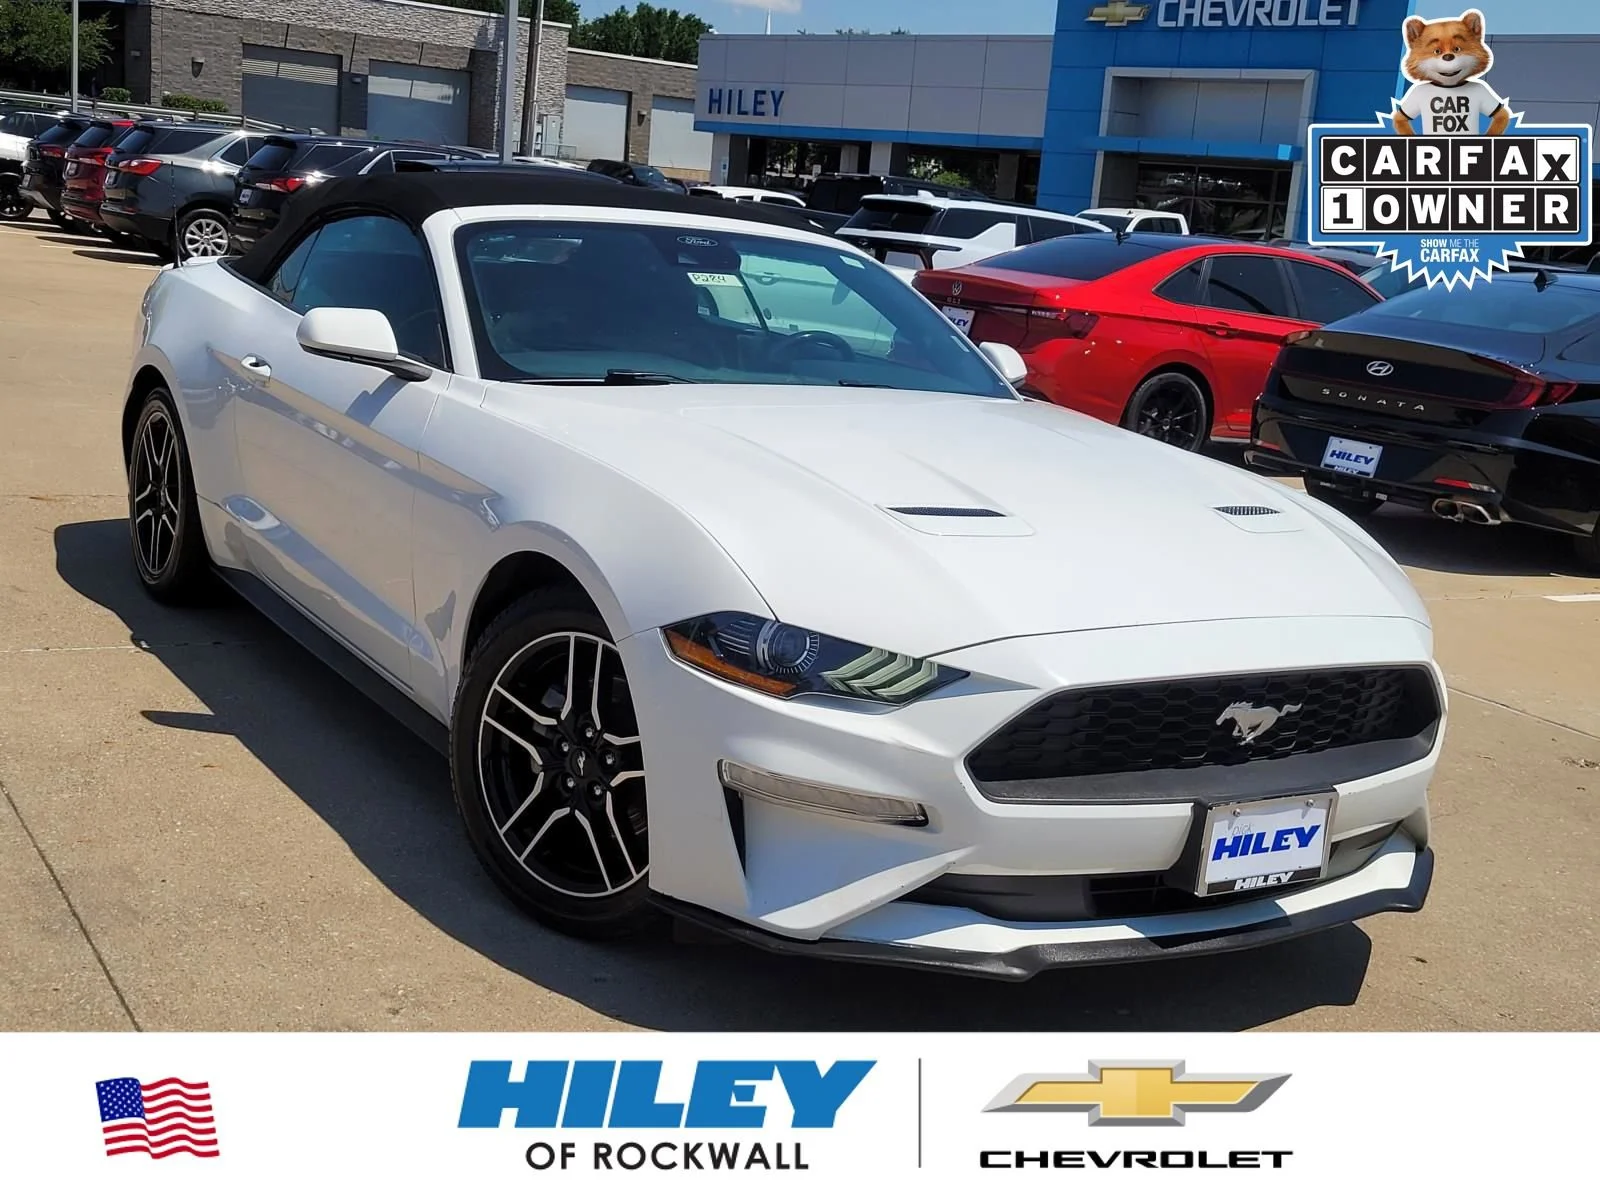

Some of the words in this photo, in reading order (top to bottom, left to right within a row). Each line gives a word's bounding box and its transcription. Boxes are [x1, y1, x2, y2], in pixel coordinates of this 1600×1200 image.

[1157, 0, 1360, 28] CHEVROLET
[708, 87, 785, 117] HILEY
[1321, 388, 1425, 411] SONATA
[1329, 449, 1376, 466] HILEY
[1211, 824, 1321, 862] HILEY
[1234, 871, 1295, 891] HILEY
